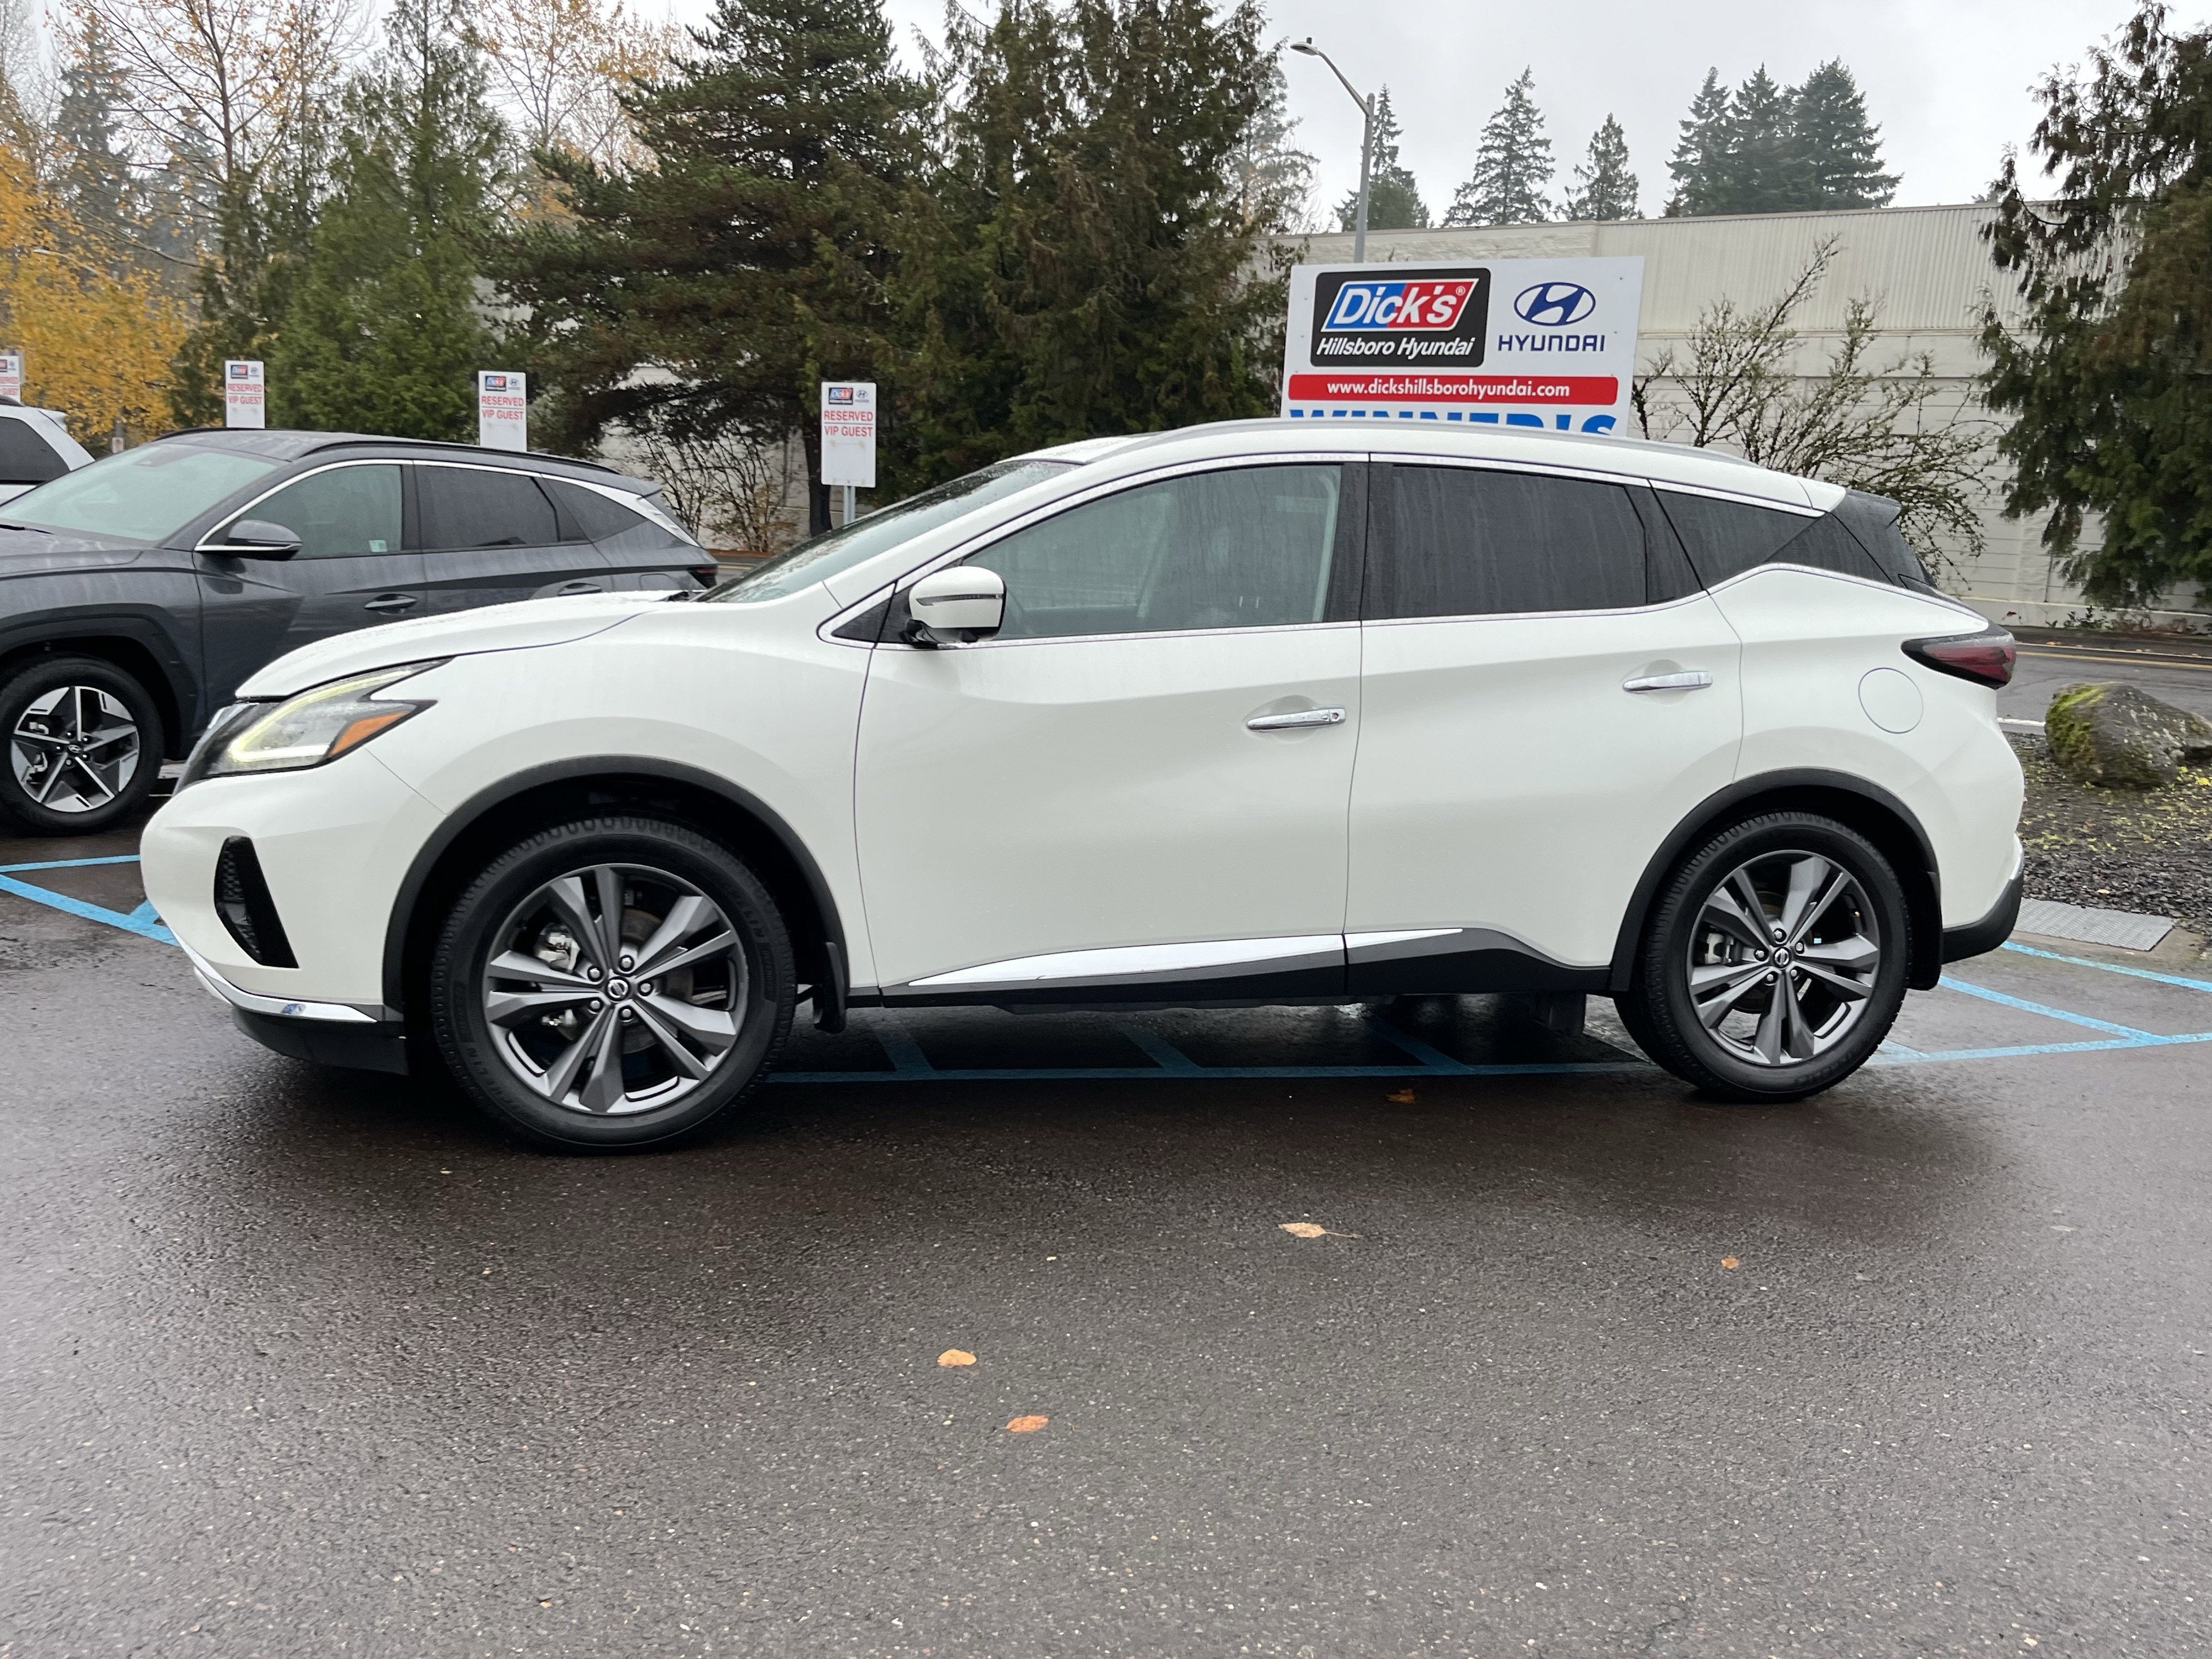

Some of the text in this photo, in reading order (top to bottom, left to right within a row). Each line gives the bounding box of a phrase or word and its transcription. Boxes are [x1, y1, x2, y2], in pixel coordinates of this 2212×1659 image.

[1333, 285, 1457, 324] Dick's
[1316, 337, 1476, 360] Hillsboro Hyundai
[1498, 335, 1605, 352] HYUNDAI
[1327, 379, 1570, 399] www.dickshillsborohyundai.com
[481, 396, 524, 407] RESERVED
[482, 410, 524, 420] VIP GUEST
[824, 410, 873, 422] RESERVED
[824, 426, 873, 437] VIP GUEST
